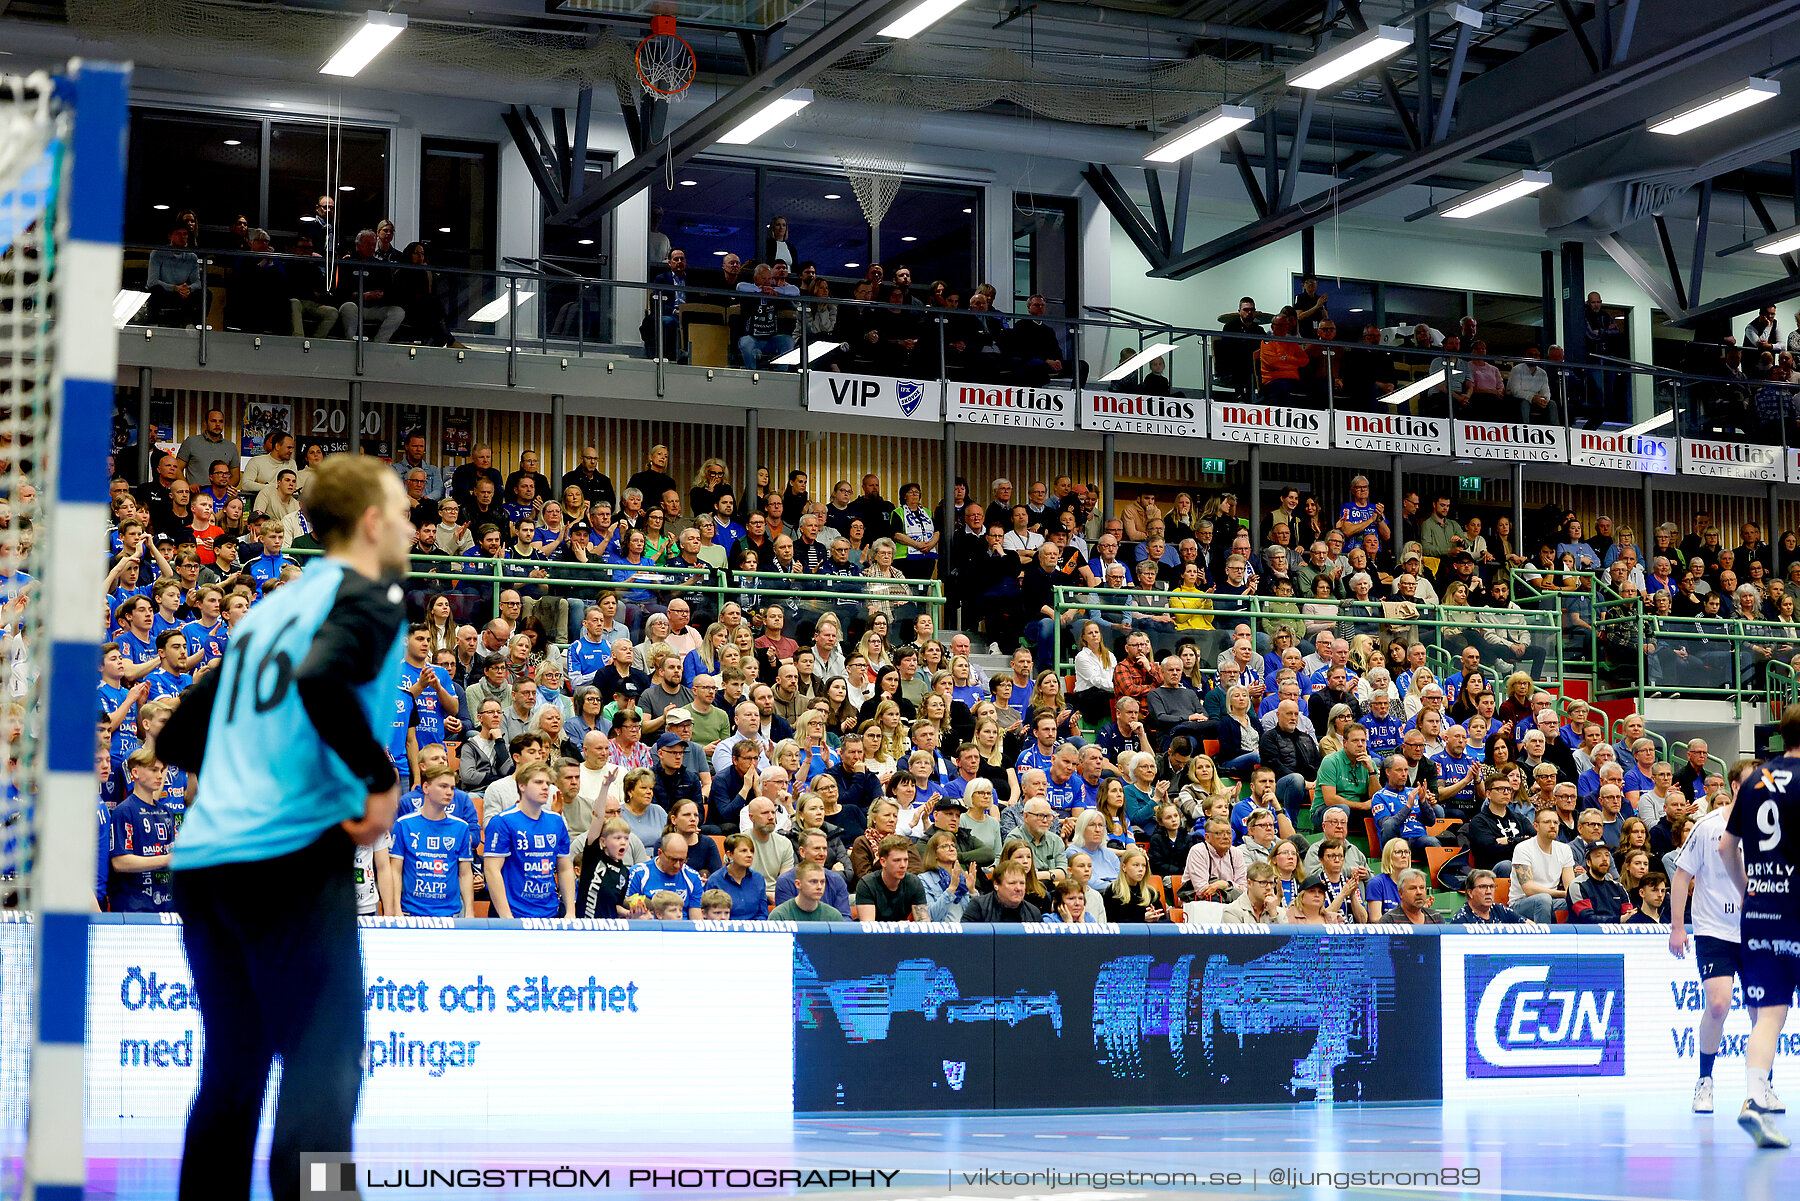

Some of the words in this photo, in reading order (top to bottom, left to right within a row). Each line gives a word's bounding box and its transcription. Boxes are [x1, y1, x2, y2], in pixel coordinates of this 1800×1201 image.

[828, 378, 881, 408] VIP
[959, 386, 1064, 412] mattias
[1093, 395, 1195, 420] mattias
[968, 411, 1055, 429] CATERING
[1223, 406, 1319, 431] mattias
[1346, 415, 1440, 438] mattias
[1102, 419, 1187, 436] CATERING
[1465, 424, 1556, 446] mattias
[1231, 430, 1311, 447] CATERING
[1354, 438, 1433, 453] CATERING
[1581, 433, 1667, 457] mattias
[1474, 447, 1550, 461] CATERING
[1691, 443, 1775, 465] mattias
[1588, 456, 1660, 472] CATERING
[1699, 465, 1769, 480] CATERING
[226, 616, 293, 724] 16
[402, 681, 412, 690] 30
[420, 716, 438, 728] APP
[1388, 802, 1395, 813] 7
[143, 818, 152, 833] 9
[1757, 799, 1782, 852] 9
[410, 838, 418, 849] 4
[516, 839, 529, 850] 33
[415, 860, 449, 872] DALOC
[524, 861, 554, 872] DALOC
[414, 878, 447, 894] RAPP
[440, 975, 496, 1013] och
[506, 975, 639, 1013] säkerhet
[1475, 964, 1616, 1068] CEJN
[120, 1030, 193, 1067] med
